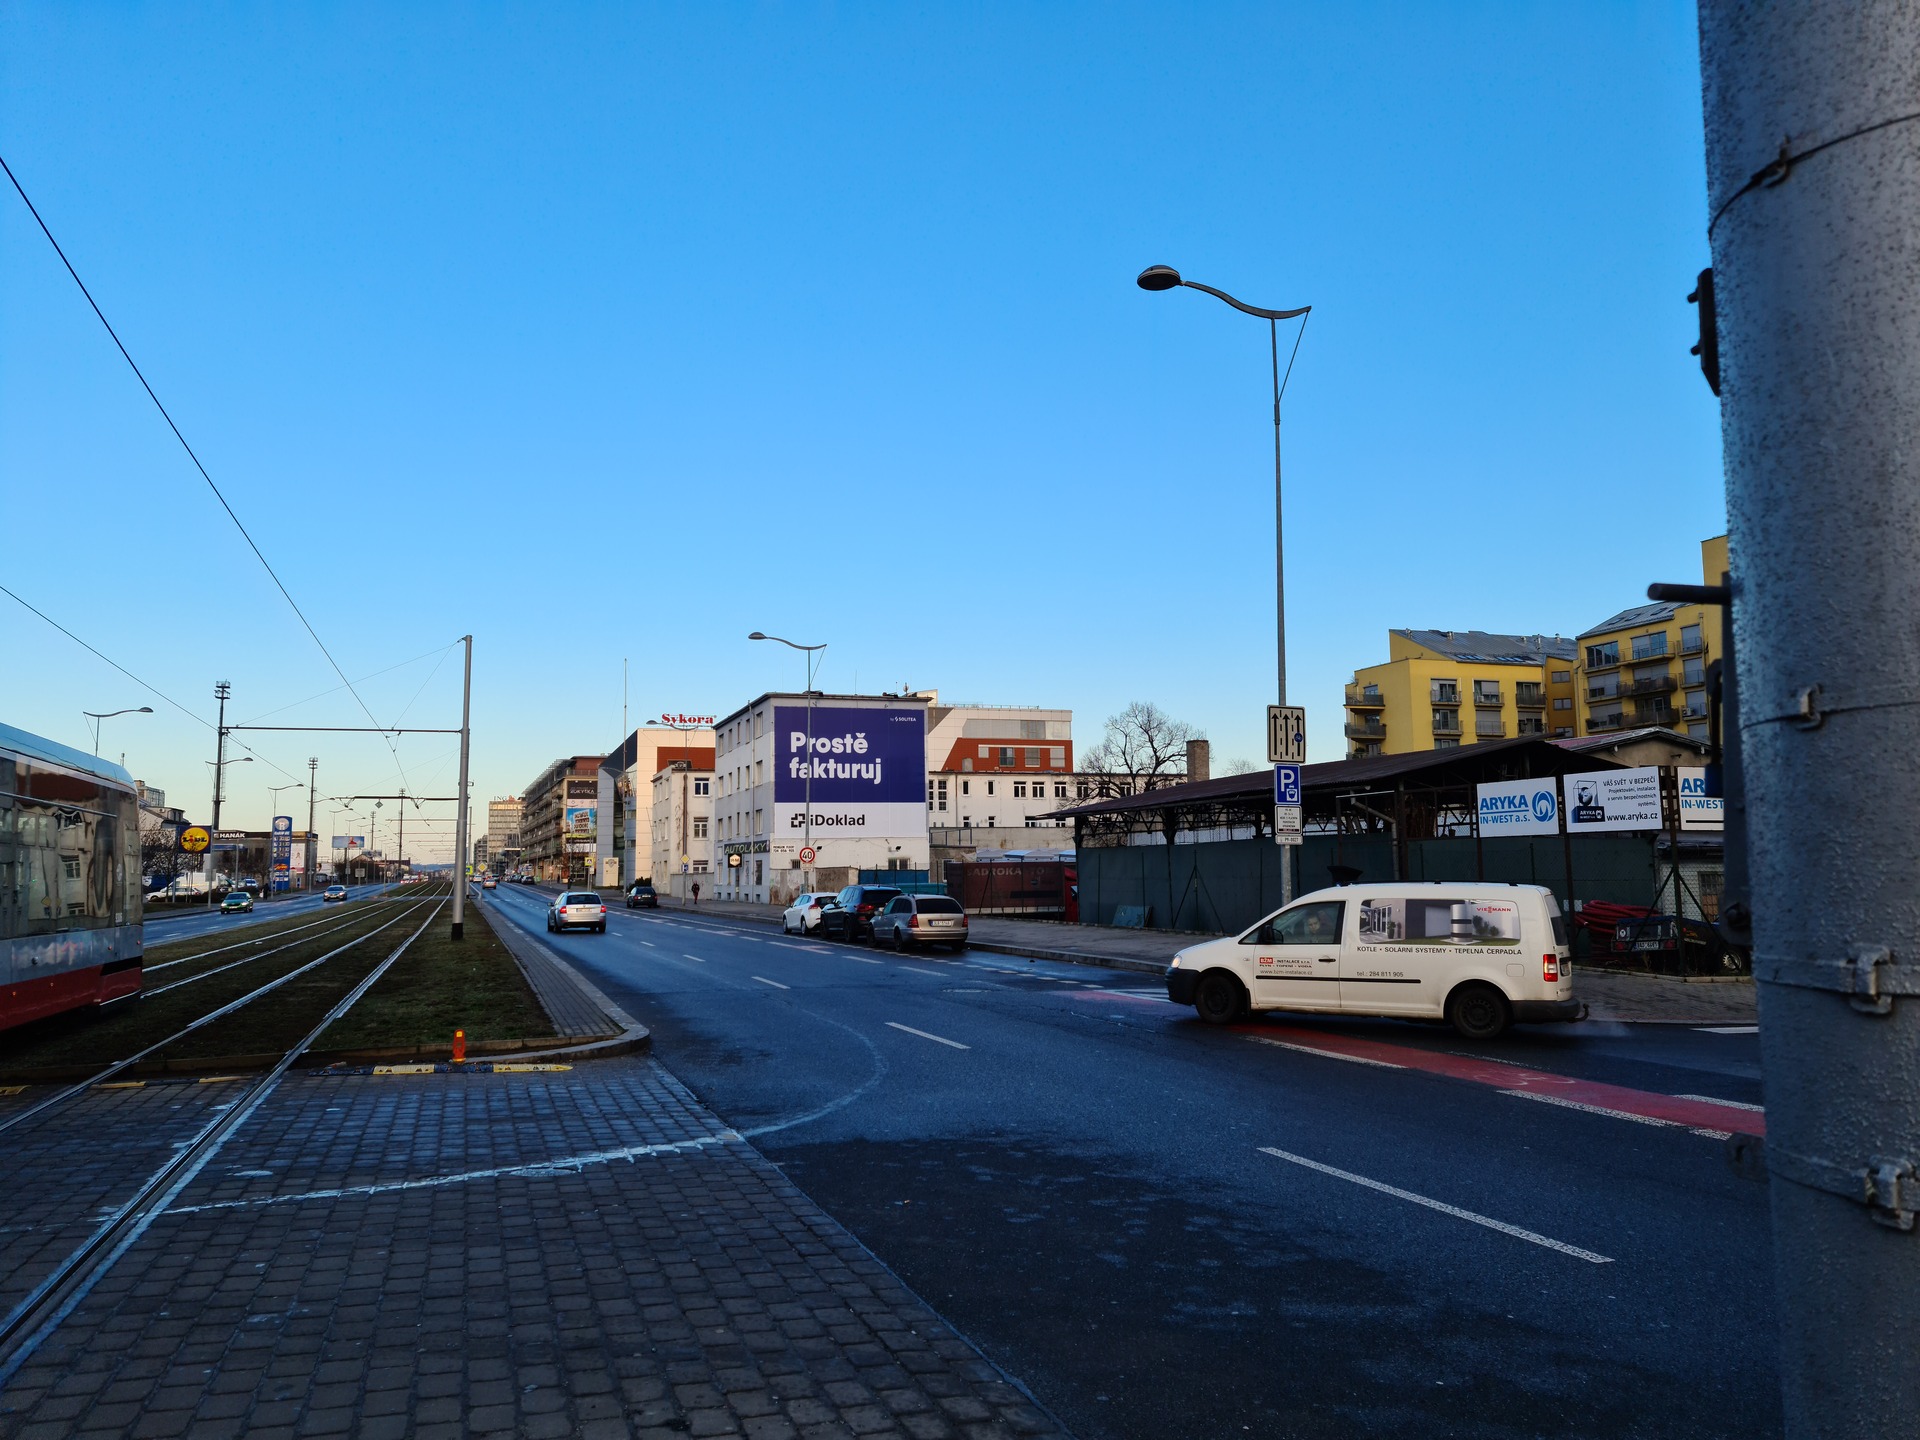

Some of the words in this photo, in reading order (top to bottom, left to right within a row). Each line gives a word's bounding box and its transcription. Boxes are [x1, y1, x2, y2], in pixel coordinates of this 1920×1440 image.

[662, 713, 713, 726] Sykora
[790, 732, 868, 754] Prostě
[789, 757, 881, 785] fakturuj
[1280, 769, 1295, 792] P
[1603, 778, 1613, 787] VÁŠ
[1614, 778, 1626, 786] SVĚT
[1634, 776, 1656, 785] BEZPEČÍ
[1480, 794, 1529, 811] ARYKA
[1681, 800, 1724, 809] IN-WEST
[810, 814, 865, 826] iDoklad
[1480, 815, 1513, 824] IN-WEST
[1515, 814, 1530, 823] a.s.
[1606, 812, 1658, 822] www.aryka.cz
[725, 842, 766, 854] AUTOLAKY
[802, 851, 812, 859] 40
[1486, 947, 1522, 955] ČERPADLA
